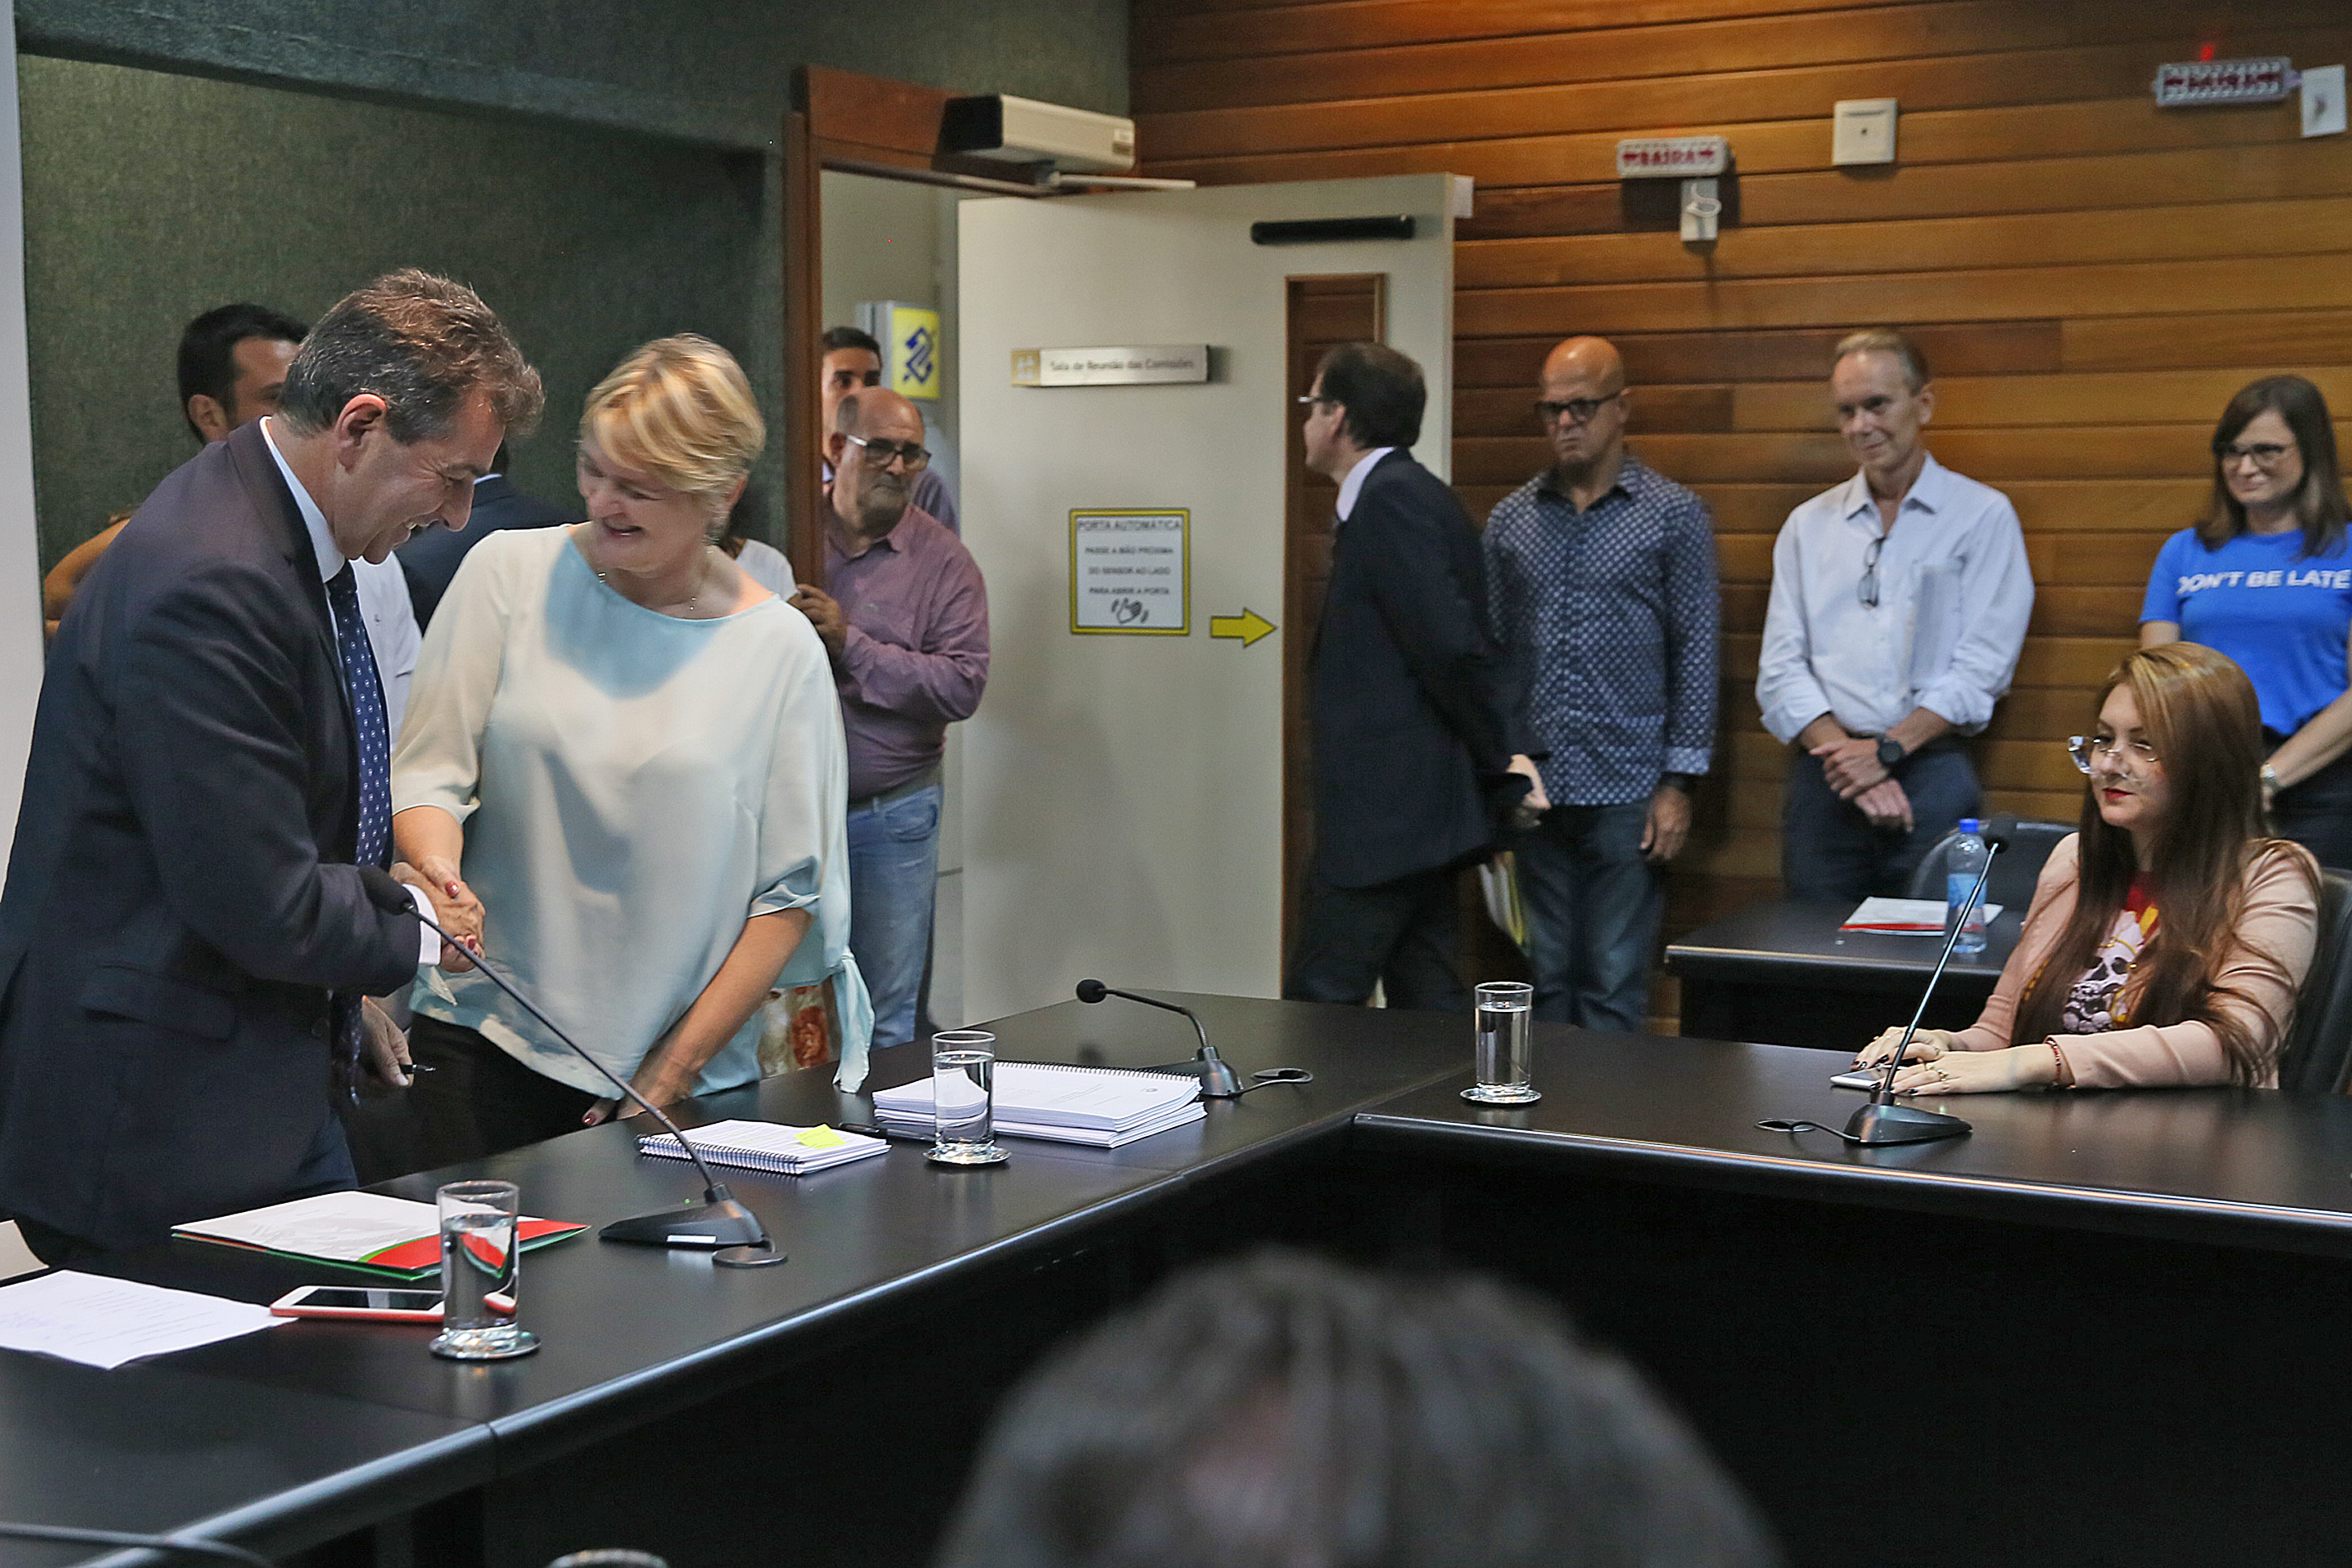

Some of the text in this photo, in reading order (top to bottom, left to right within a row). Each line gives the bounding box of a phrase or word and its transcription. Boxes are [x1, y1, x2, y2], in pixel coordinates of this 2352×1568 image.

[1077, 519, 1111, 531] PORTA
[2246, 570, 2283, 588] BE
[2287, 569, 2352, 590] LATE
